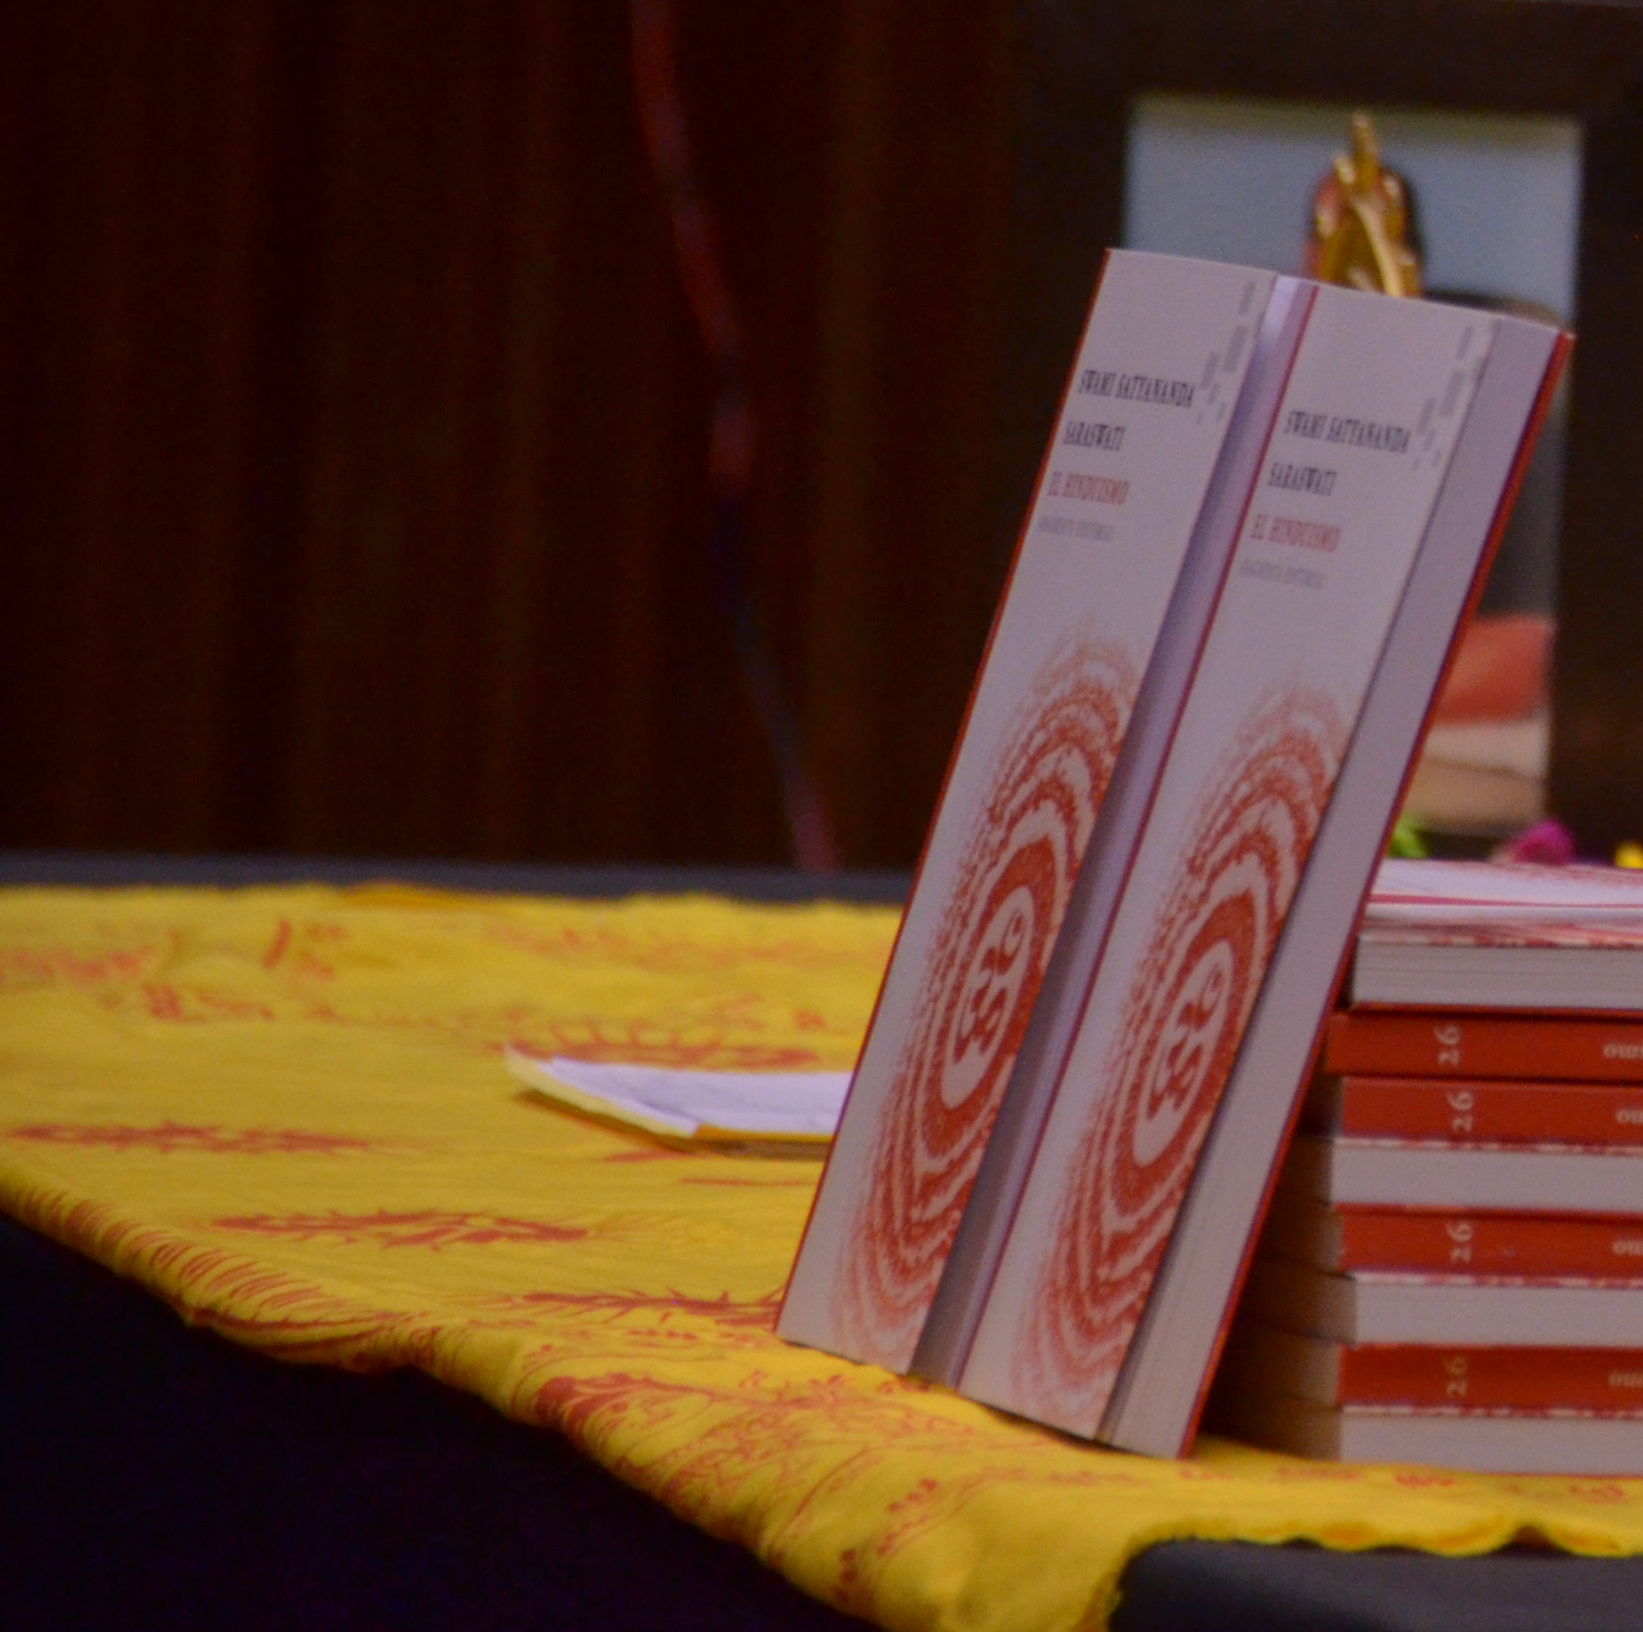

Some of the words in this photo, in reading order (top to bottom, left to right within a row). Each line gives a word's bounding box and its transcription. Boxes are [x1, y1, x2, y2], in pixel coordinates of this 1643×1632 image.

[1078, 369, 1116, 397] SWAMI
[1062, 420, 1126, 452] SARASWATI
[1283, 410, 1328, 440] SWAMI
[1268, 463, 1338, 497] SARASWATI
